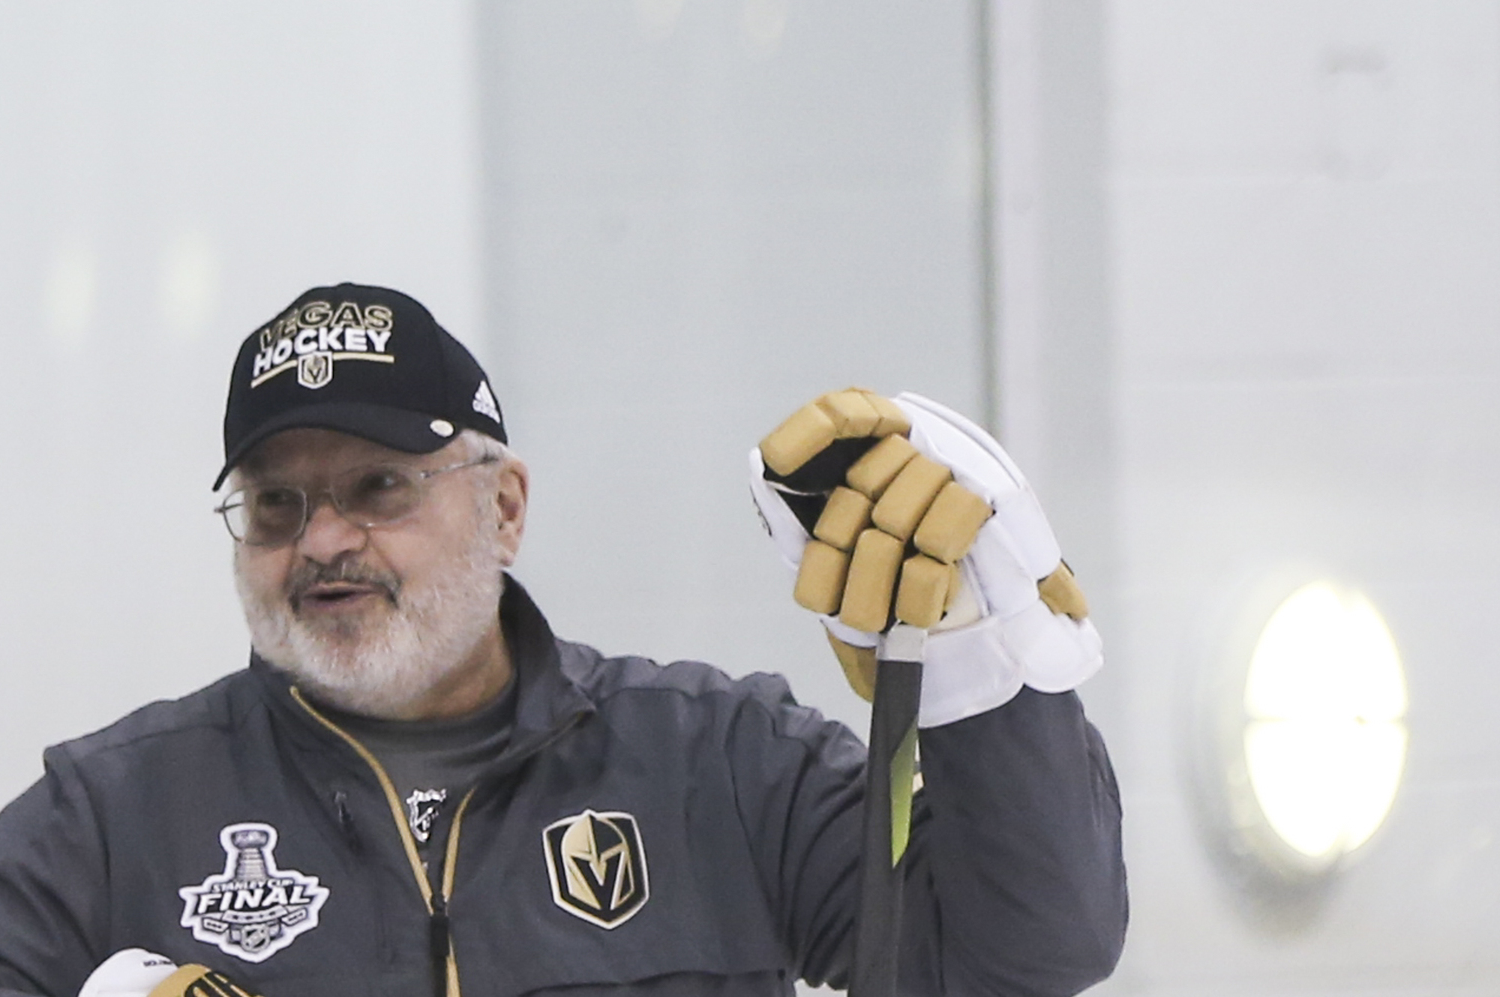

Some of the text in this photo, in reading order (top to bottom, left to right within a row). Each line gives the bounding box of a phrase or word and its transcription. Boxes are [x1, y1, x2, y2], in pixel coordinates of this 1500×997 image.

[260, 301, 393, 350] VEGAS
[253, 327, 392, 378] HOCKEY
[198, 886, 311, 914] FINAL
